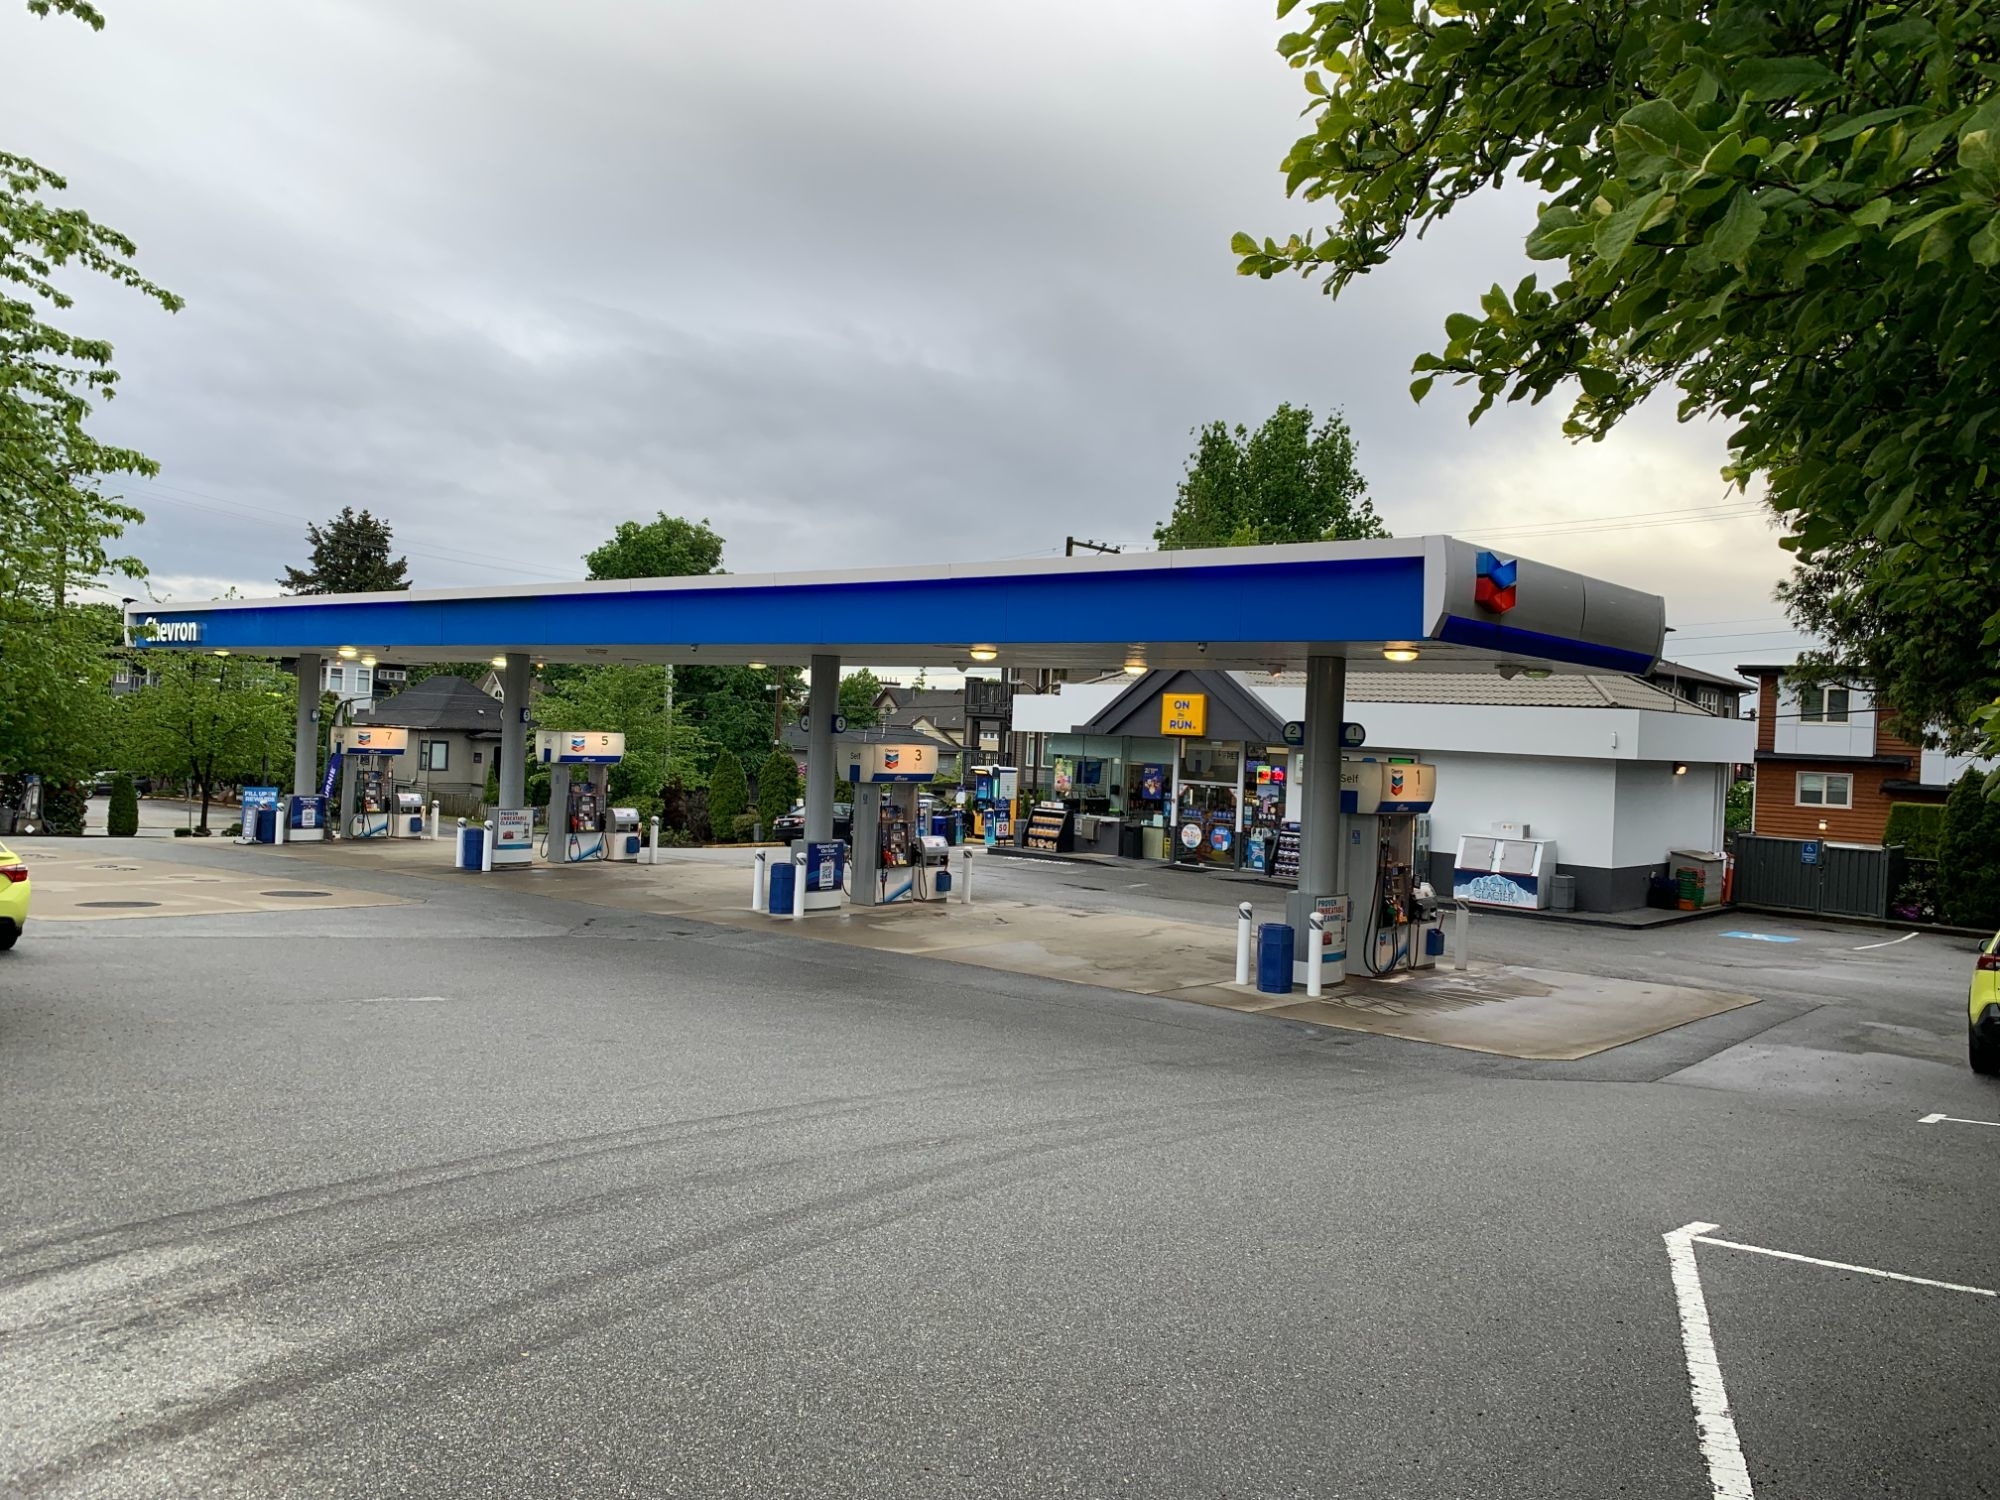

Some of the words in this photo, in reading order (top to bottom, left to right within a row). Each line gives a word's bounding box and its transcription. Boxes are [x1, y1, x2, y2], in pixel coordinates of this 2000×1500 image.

[145, 616, 197, 642] Chevron
[1174, 700, 1190, 710] ON
[1289, 725, 1297, 735] 2
[1353, 727, 1357, 737] 1
[385, 731, 393, 741] 7
[601, 735, 609, 746] 5
[850, 752, 861, 760] Self
[915, 749, 922, 761] 3
[1340, 774, 1359, 783] Self
[1416, 769, 1421, 785] 1
[1473, 879, 1517, 894] ARCTIC
[1473, 889, 1515, 902] GLACIER
